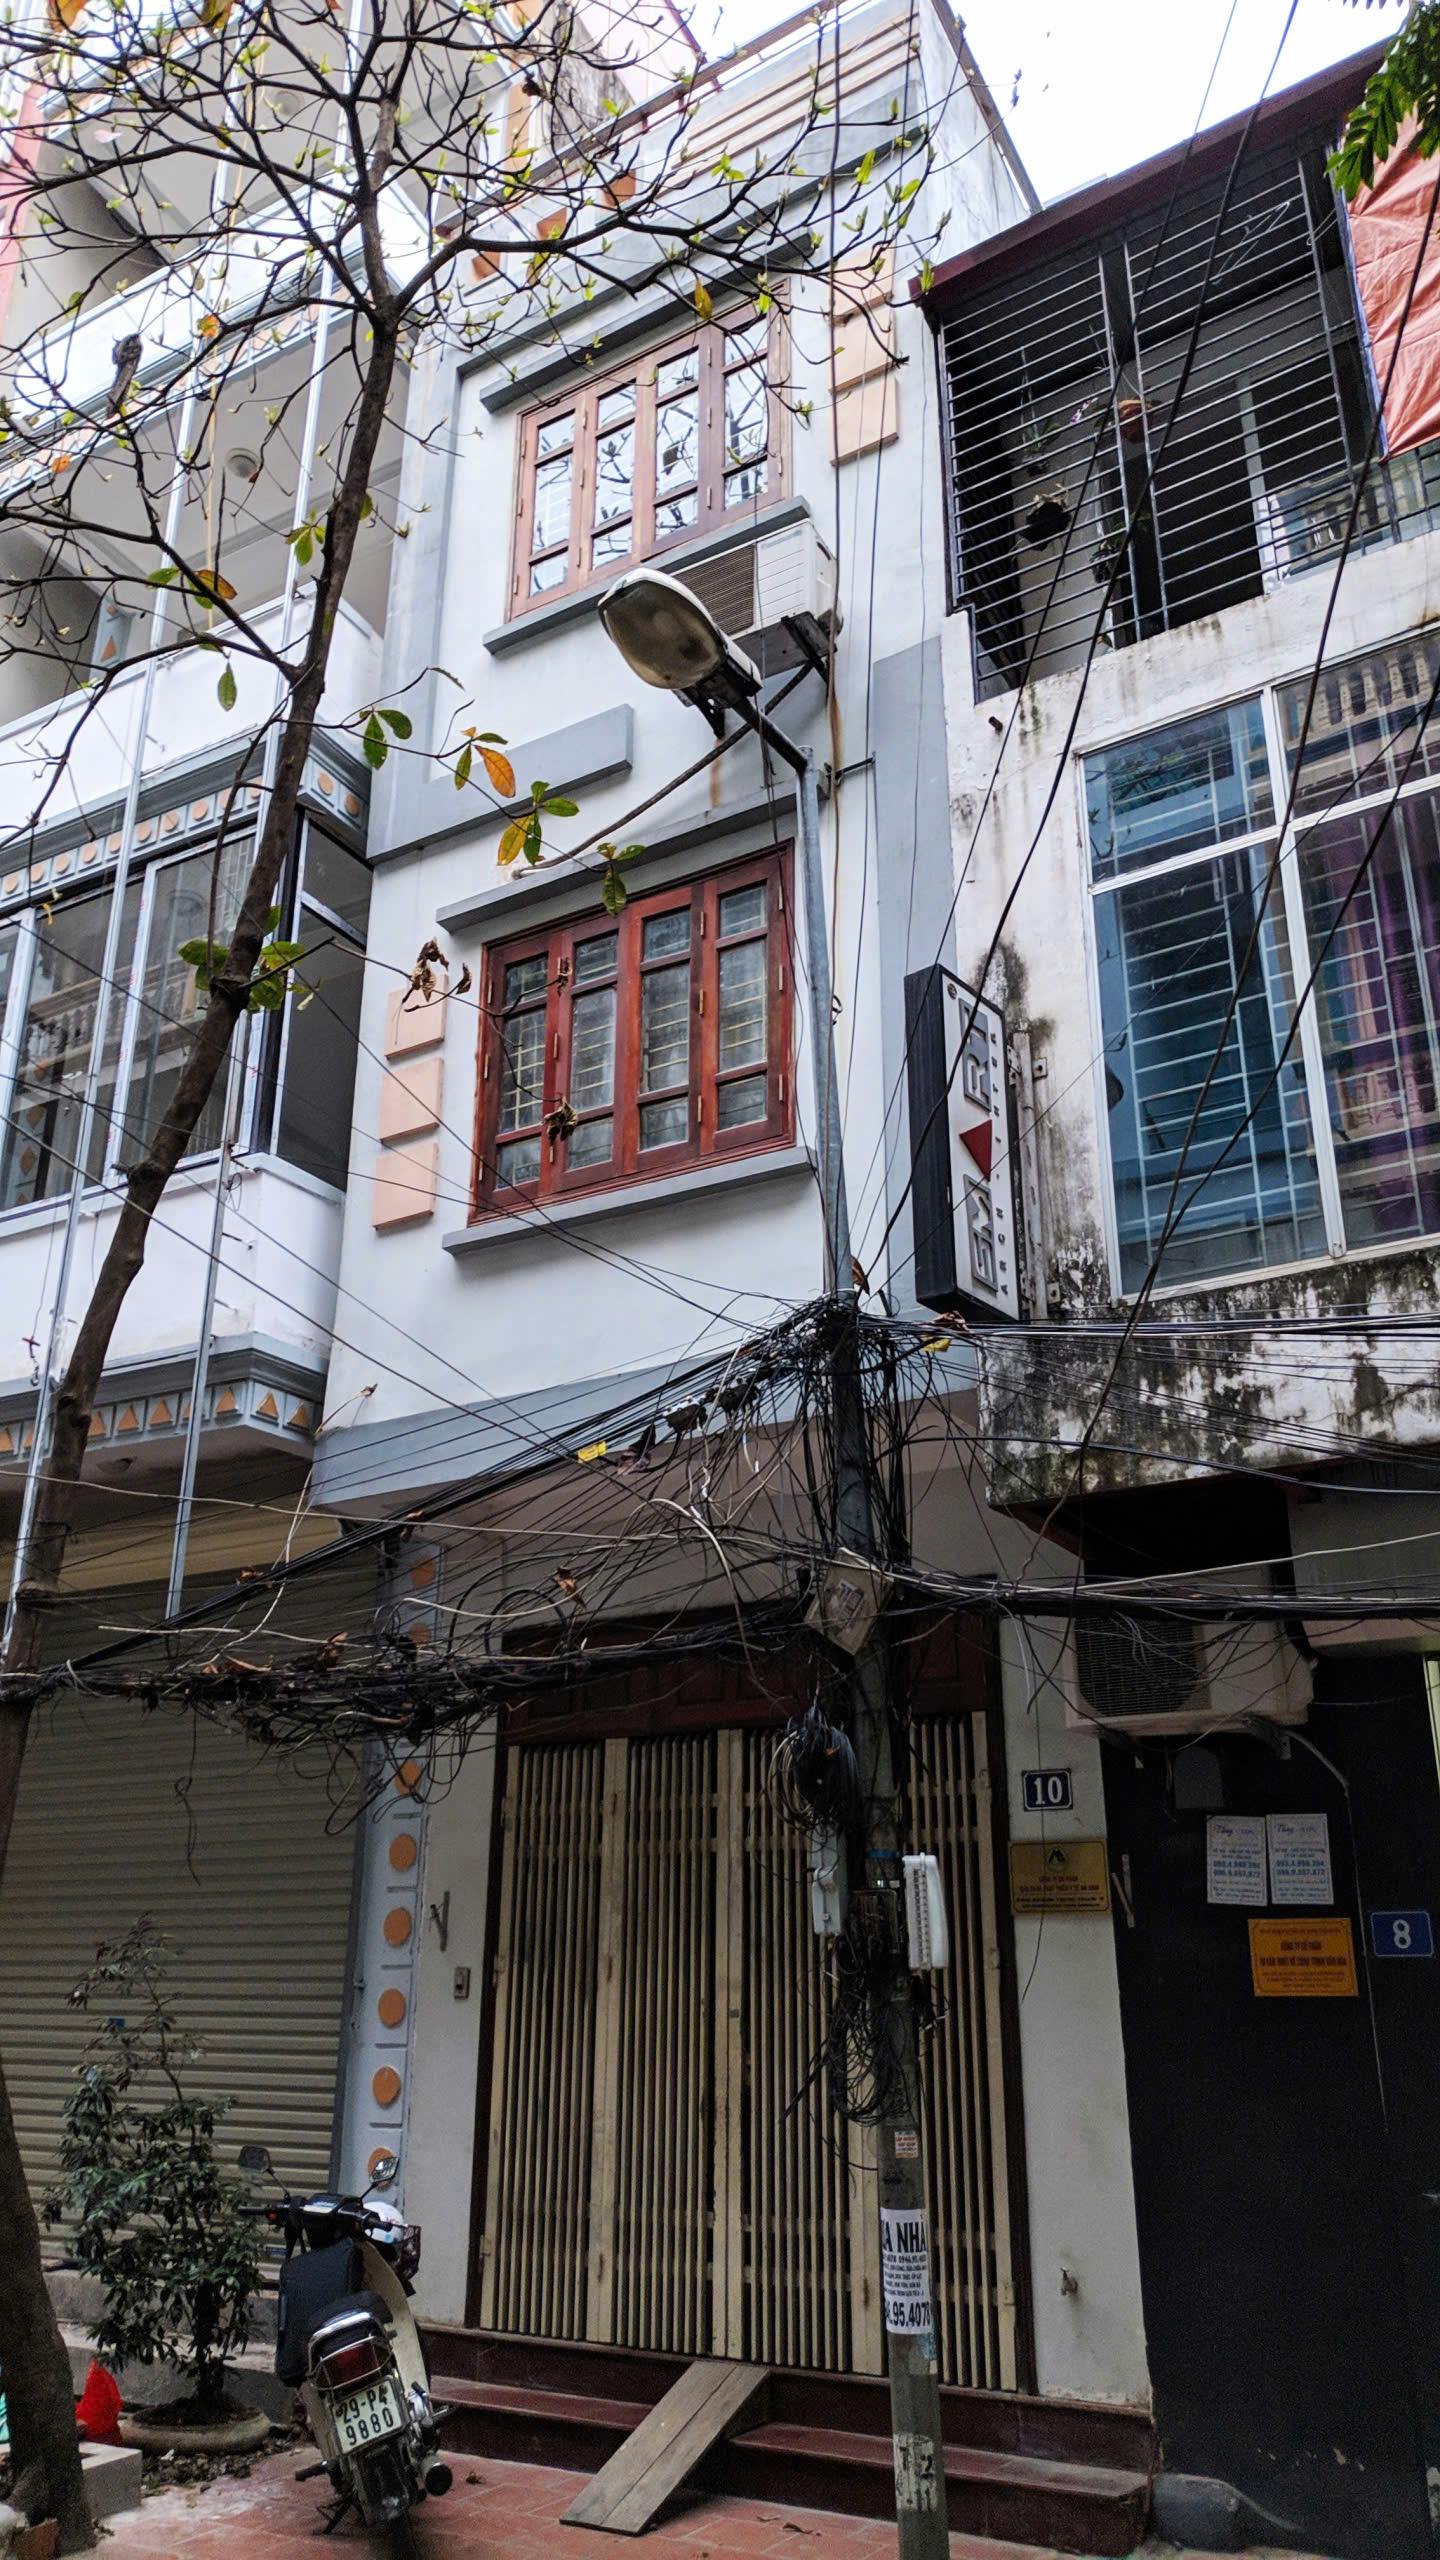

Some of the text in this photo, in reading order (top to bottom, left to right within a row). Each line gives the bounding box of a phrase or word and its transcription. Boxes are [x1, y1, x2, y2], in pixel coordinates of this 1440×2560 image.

[1033, 1776, 1063, 1805] 10
[1392, 1919, 1412, 1949] 8
[336, 2384, 388, 2424] 29-P4
[345, 2407, 394, 2446] 9880
